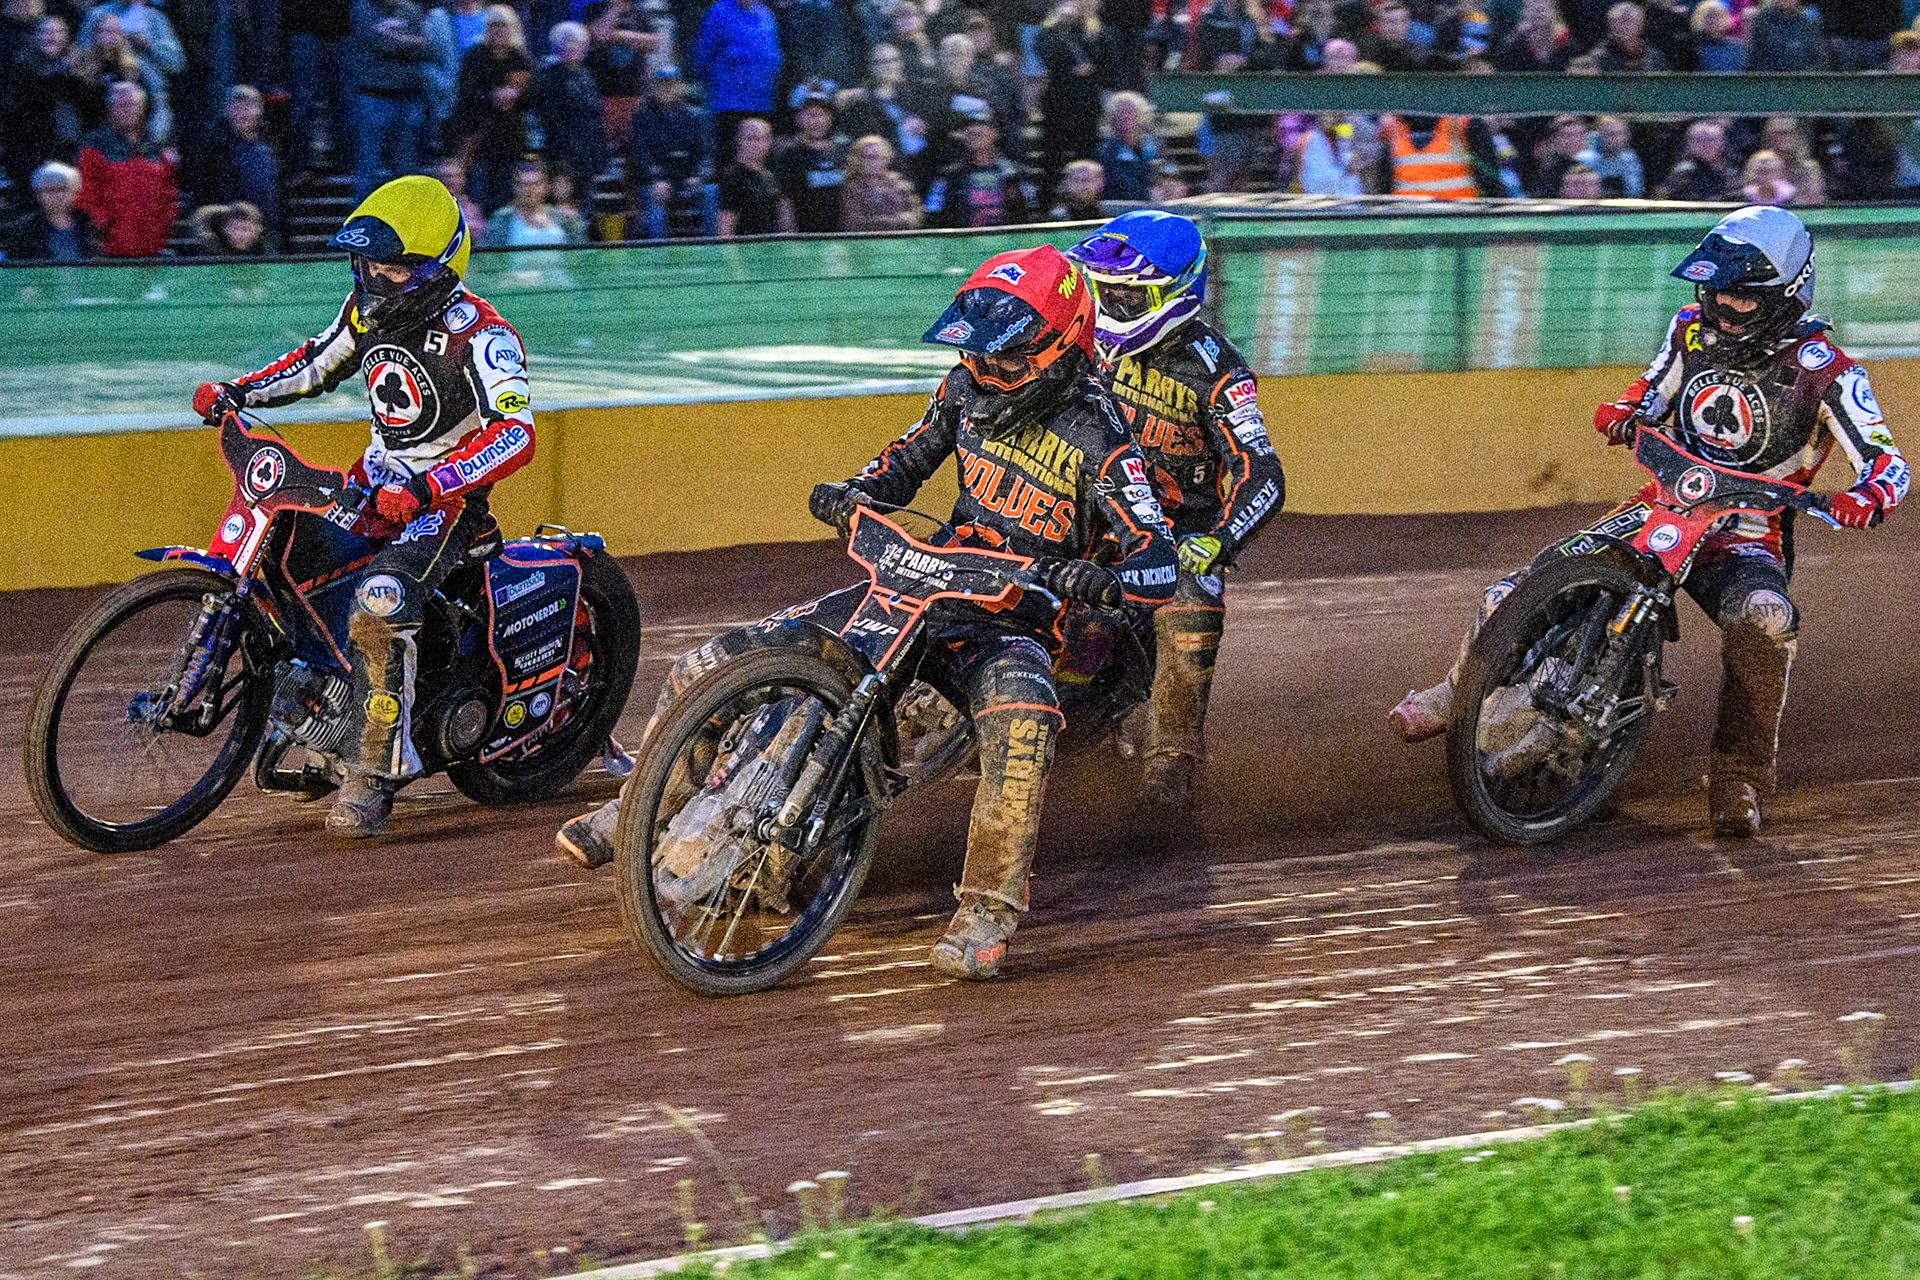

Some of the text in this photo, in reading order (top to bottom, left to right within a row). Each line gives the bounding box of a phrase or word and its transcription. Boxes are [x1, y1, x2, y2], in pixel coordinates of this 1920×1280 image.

[1784, 251, 1815, 297] OAKL
[427, 332, 444, 354] 5
[364, 350, 431, 396] BELLE VUE ACES
[1687, 373, 1719, 398] BELLE
[1747, 392, 1766, 424] ACES
[458, 426, 526, 477] burnside
[999, 421, 1084, 483] ARRYS
[1192, 464, 1207, 484] 5
[1654, 531, 1674, 544] ATPI
[895, 566, 949, 591] INTERNIONAL
[900, 548, 957, 581] PARRYS
[503, 601, 559, 638] MOTOVERDE
[852, 617, 900, 636] JWP
[1001, 718, 1039, 826] ARRYS
